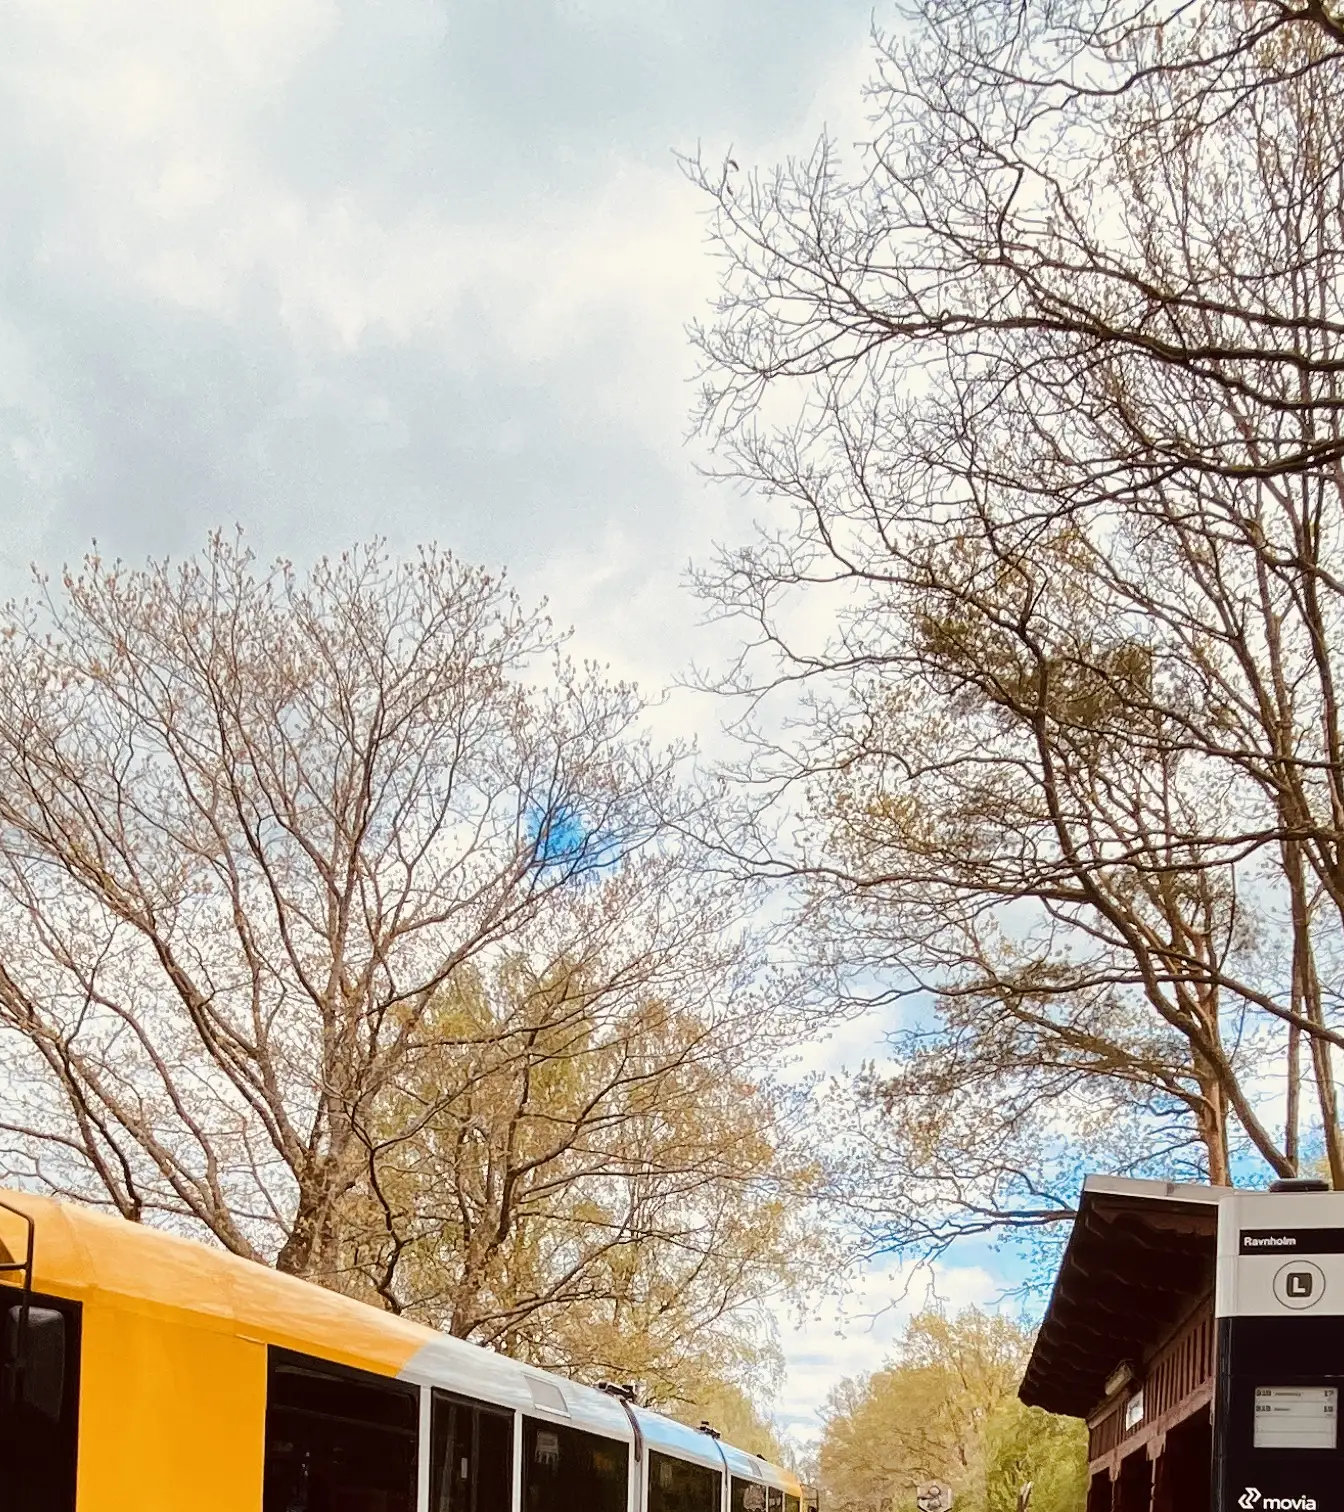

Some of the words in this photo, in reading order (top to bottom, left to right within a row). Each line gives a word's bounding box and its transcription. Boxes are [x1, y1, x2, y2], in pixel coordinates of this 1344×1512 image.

[1243, 1236, 1296, 1246] Ravnholm
[1292, 1276, 1306, 1293] L
[1262, 1494, 1317, 1510] movia
